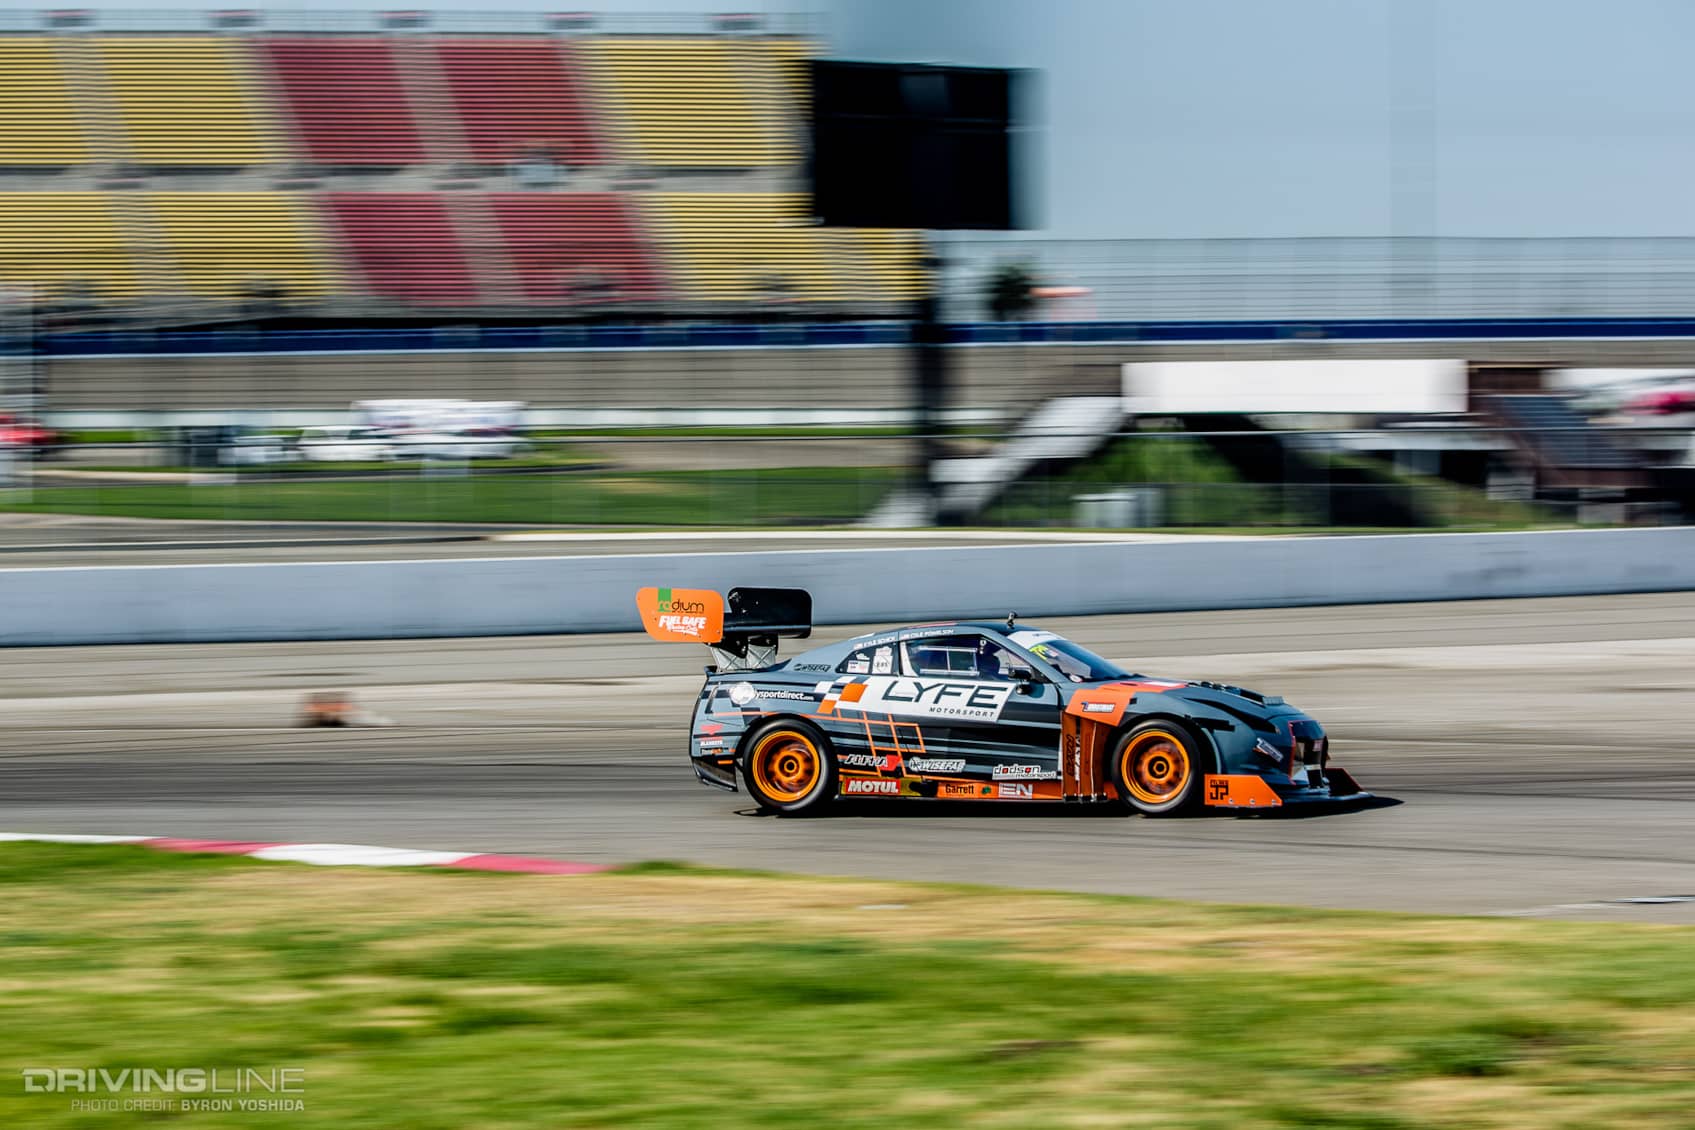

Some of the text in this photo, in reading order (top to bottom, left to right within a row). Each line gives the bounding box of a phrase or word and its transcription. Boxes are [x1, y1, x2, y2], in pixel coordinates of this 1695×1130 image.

[659, 615, 681, 629] FUEL
[881, 680, 1009, 709] LYFE
[929, 706, 995, 718] MOTORSPORT
[847, 780, 899, 793] MOTUL
[945, 784, 974, 795] Garrett
